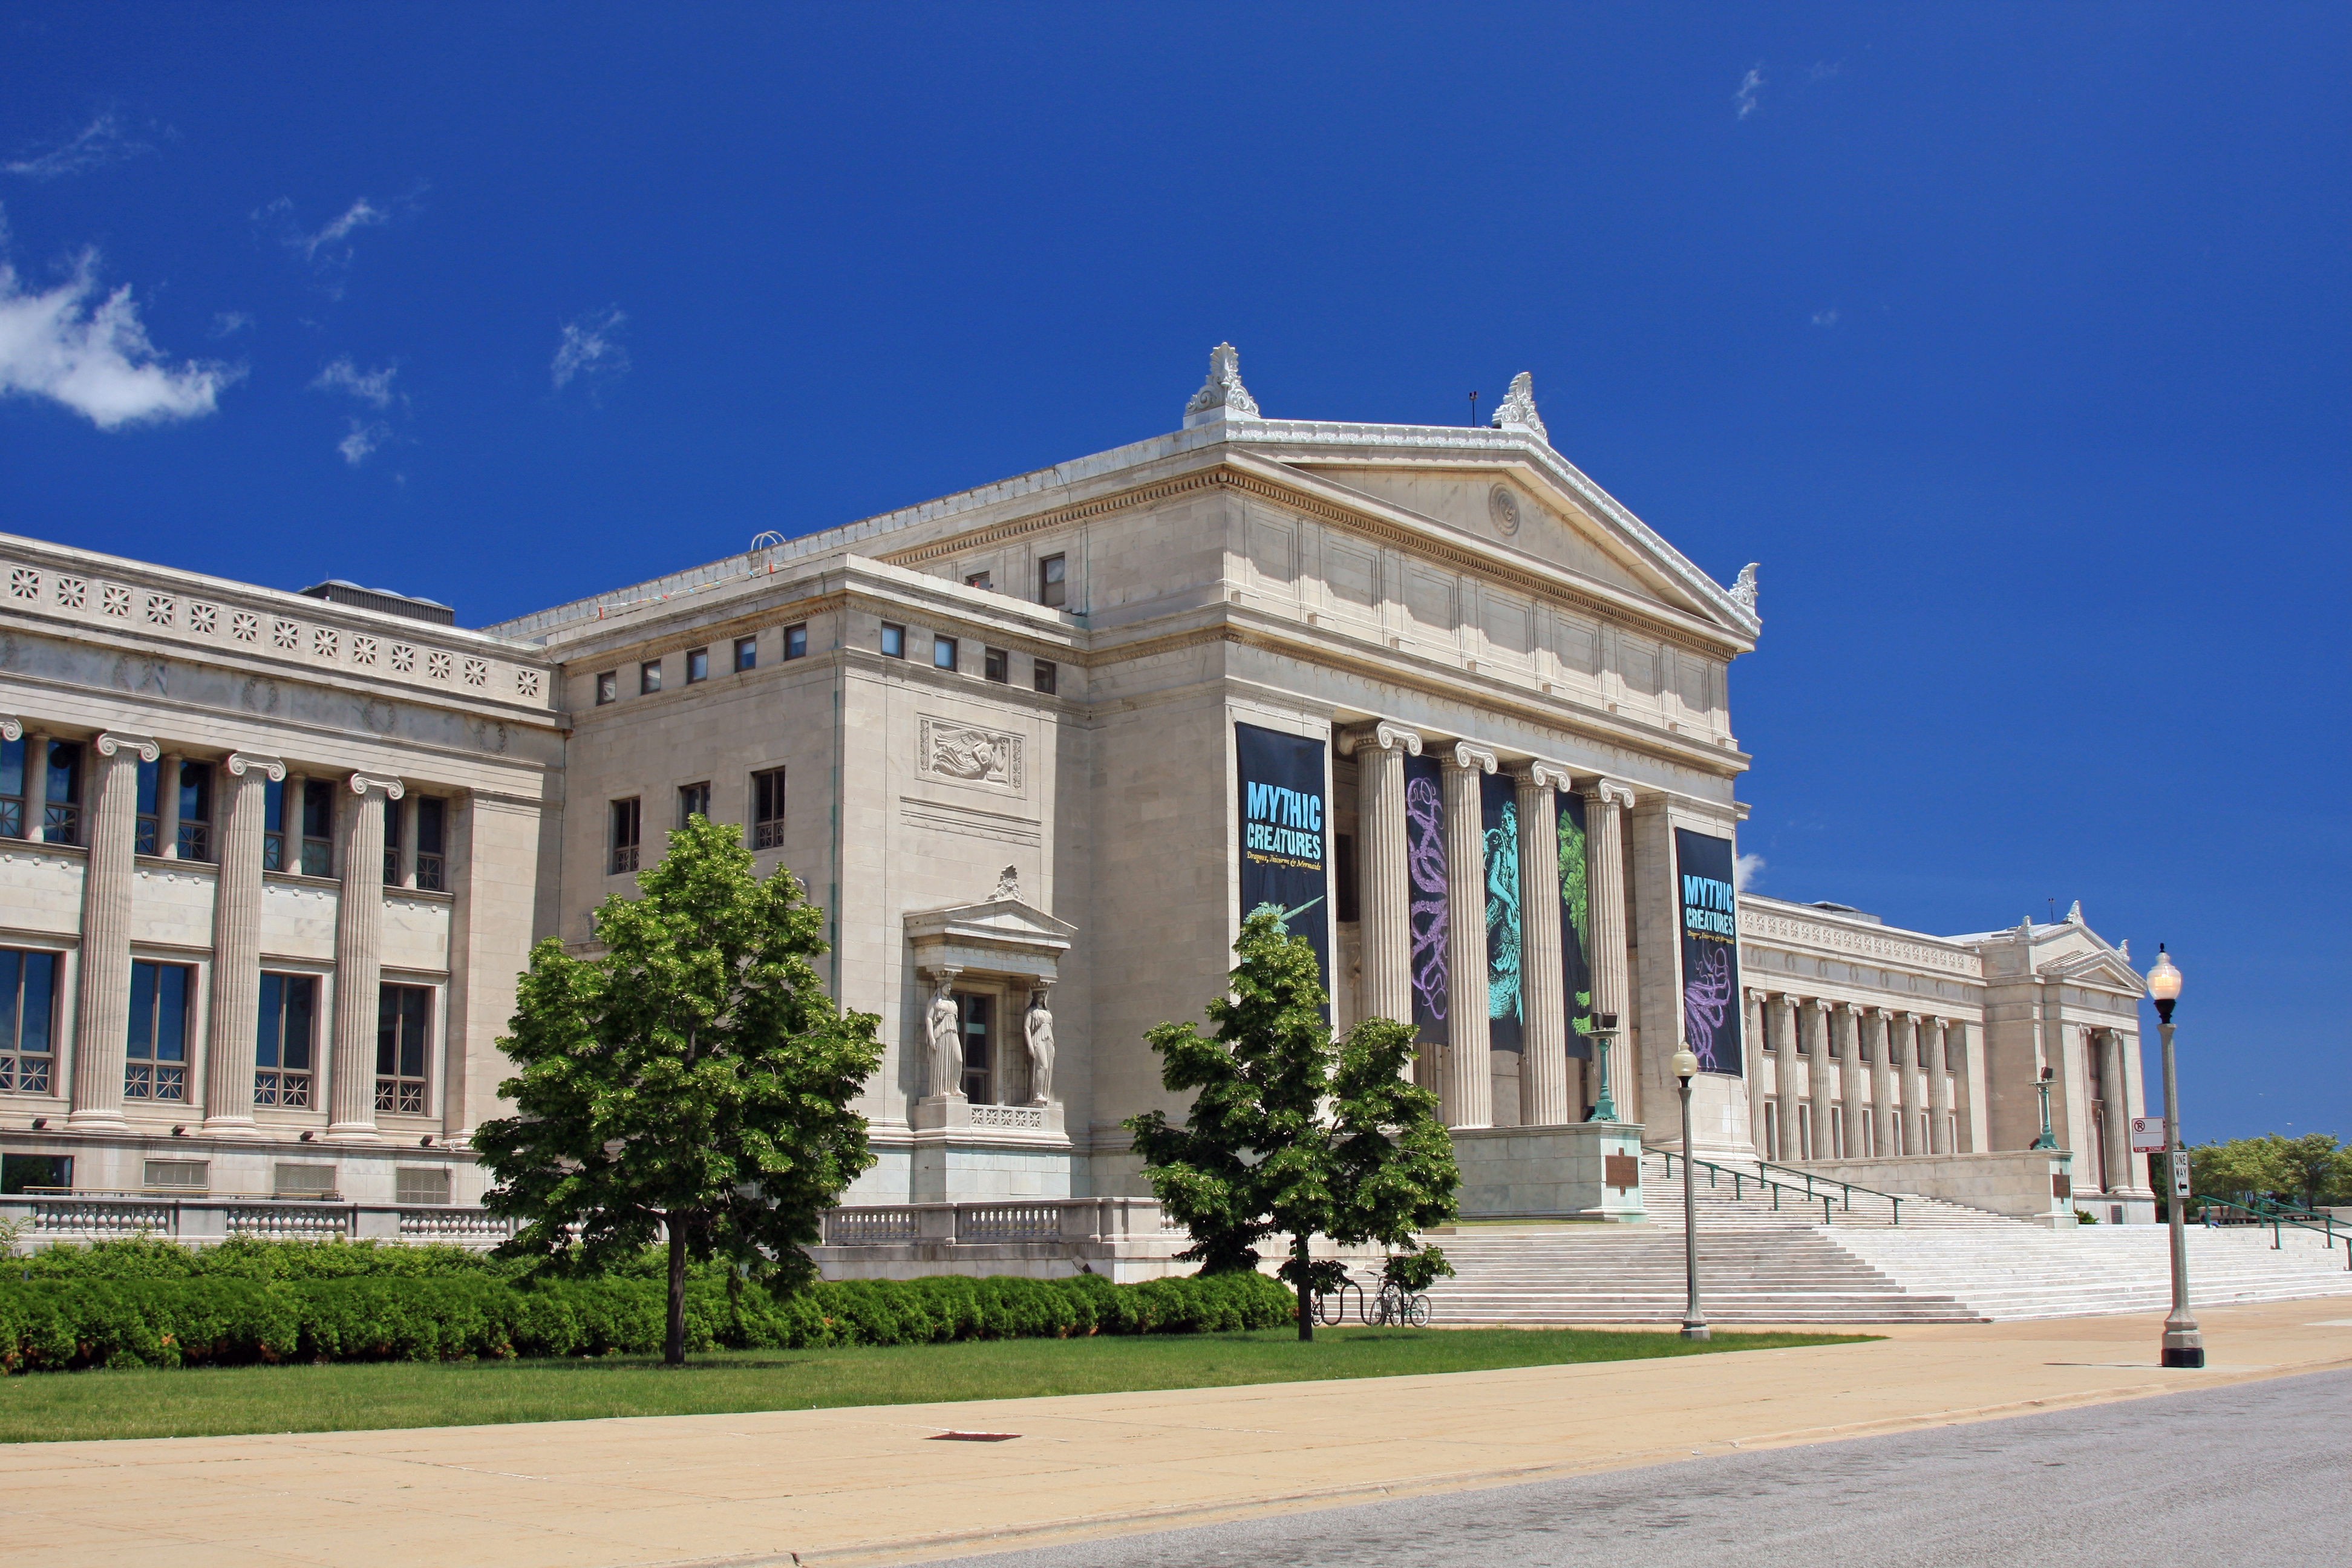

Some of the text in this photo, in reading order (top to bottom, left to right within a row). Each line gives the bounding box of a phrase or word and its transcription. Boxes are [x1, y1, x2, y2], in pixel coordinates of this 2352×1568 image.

[1247, 781, 1321, 832] MYTHIC
[1246, 822, 1321, 860] CREATURES
[1296, 859, 1321, 871] Mermaids
[1684, 874, 1733, 913] MYTHIC
[1685, 907, 1734, 936] CREATURES
[2175, 1155, 2186, 1165] ONE
[2175, 1168, 2187, 1178] WAY
